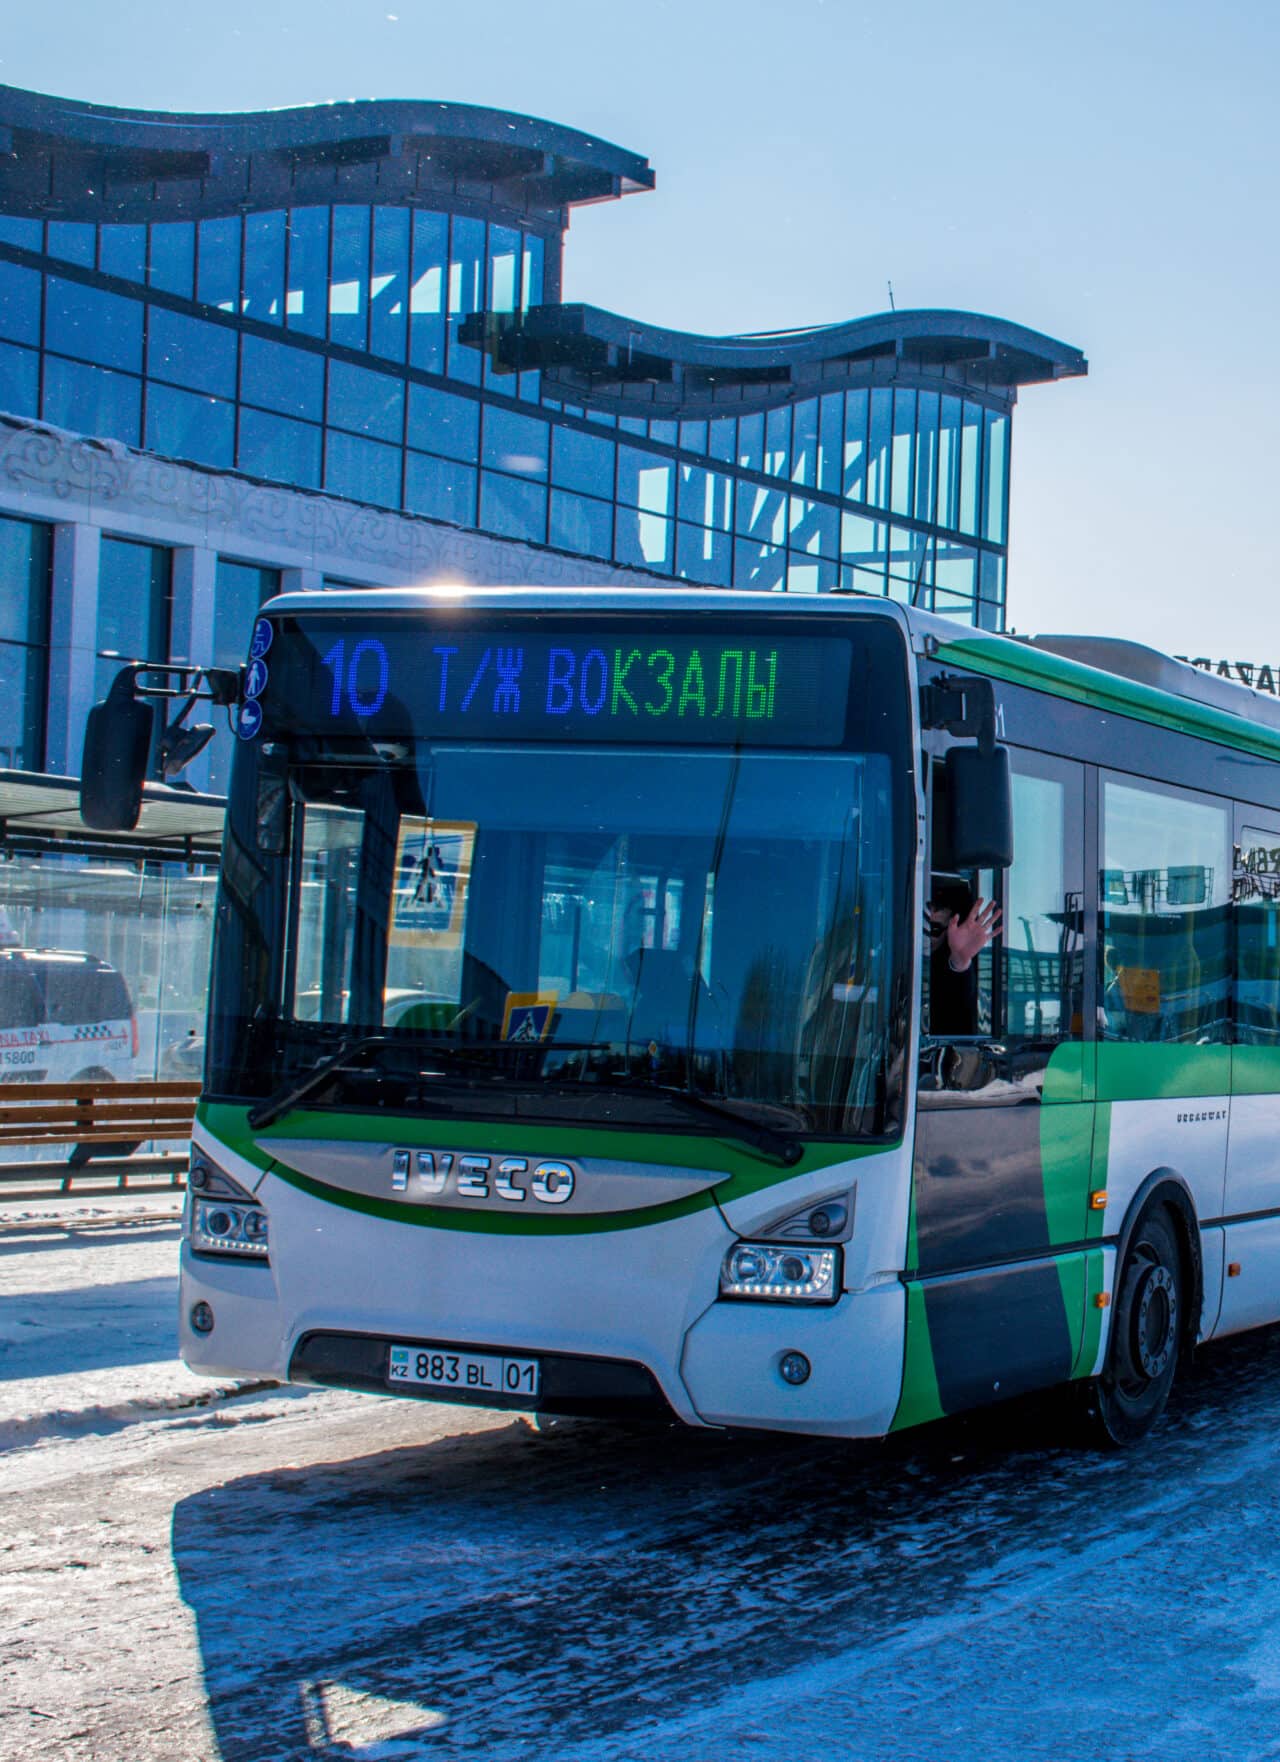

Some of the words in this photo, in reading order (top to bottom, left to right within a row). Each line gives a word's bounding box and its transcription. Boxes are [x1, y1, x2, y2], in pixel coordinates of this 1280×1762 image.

[320, 639, 389, 716] 10
[431, 647, 524, 713] Т/Ж
[545, 647, 778, 719] ВОКЗАЛЫ
[391, 1150, 576, 1204] IVECO
[391, 1364, 408, 1377] KZ
[415, 1353, 460, 1382] 883
[467, 1364, 493, 1387] BL
[507, 1363, 535, 1392] 01
